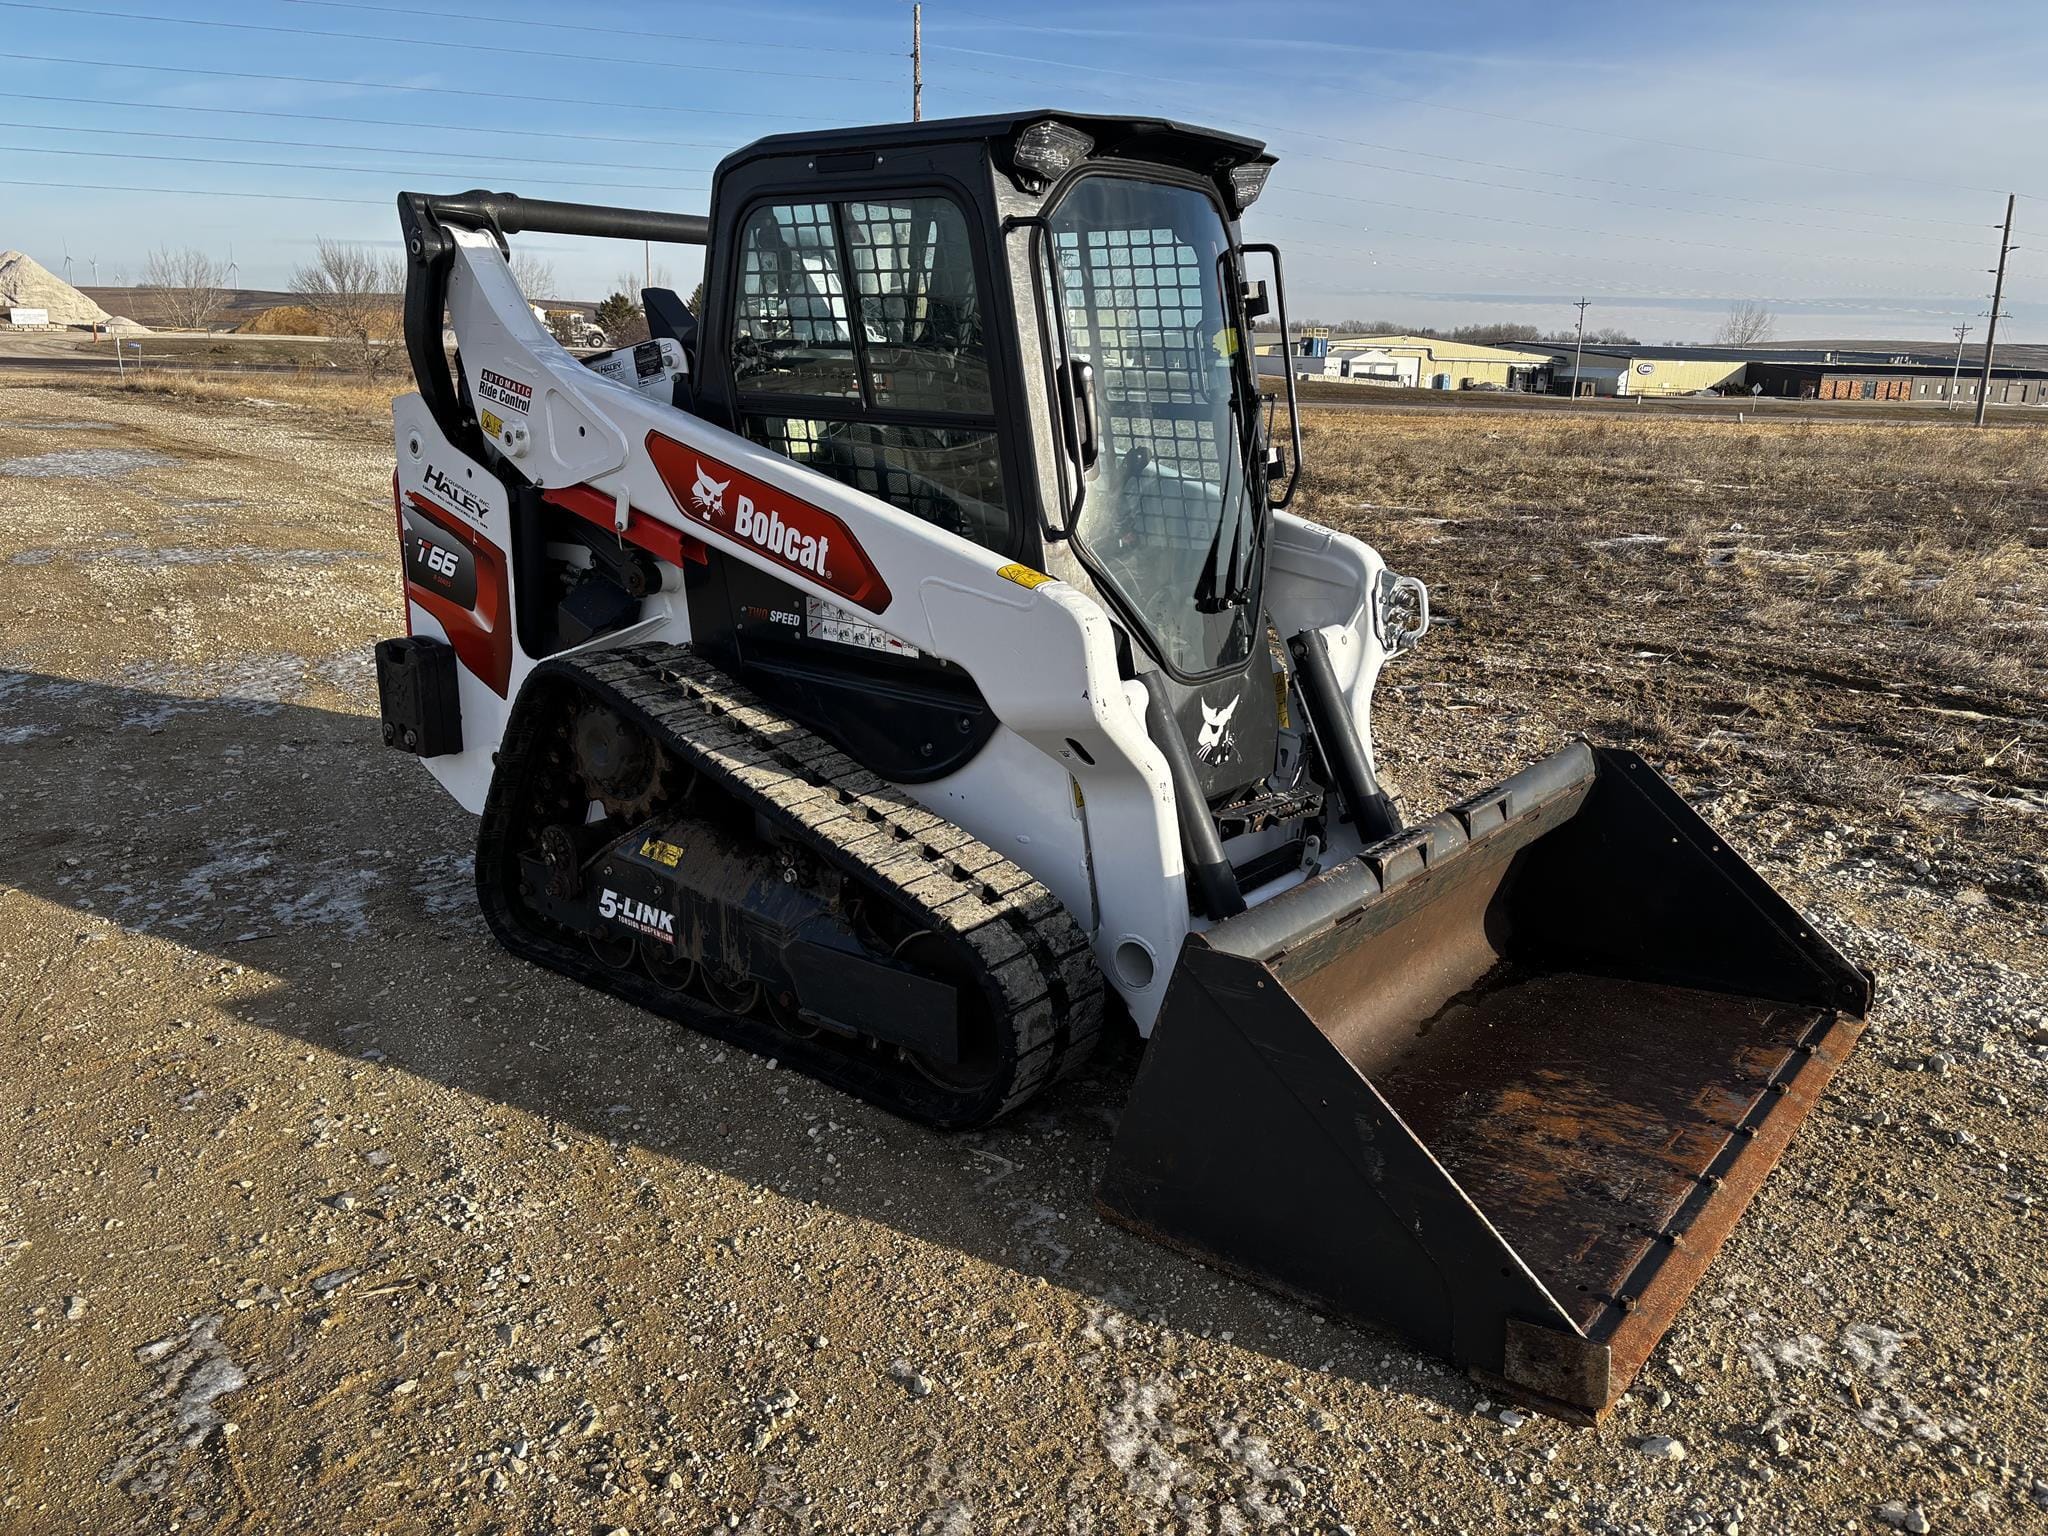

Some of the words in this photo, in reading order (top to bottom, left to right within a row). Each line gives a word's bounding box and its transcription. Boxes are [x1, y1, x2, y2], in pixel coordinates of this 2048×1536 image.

[479, 380, 498, 399] Ride
[499, 389, 531, 413] Control
[482, 371, 531, 397] AUTOMATIC
[423, 464, 490, 519] HALEY
[444, 476, 478, 500] EQUIPMENT
[734, 494, 829, 577] Bobcat
[417, 537, 460, 578] T66
[748, 606, 768, 619] TWO
[769, 610, 801, 627] SPEED
[598, 887, 676, 934] 5-LINK
